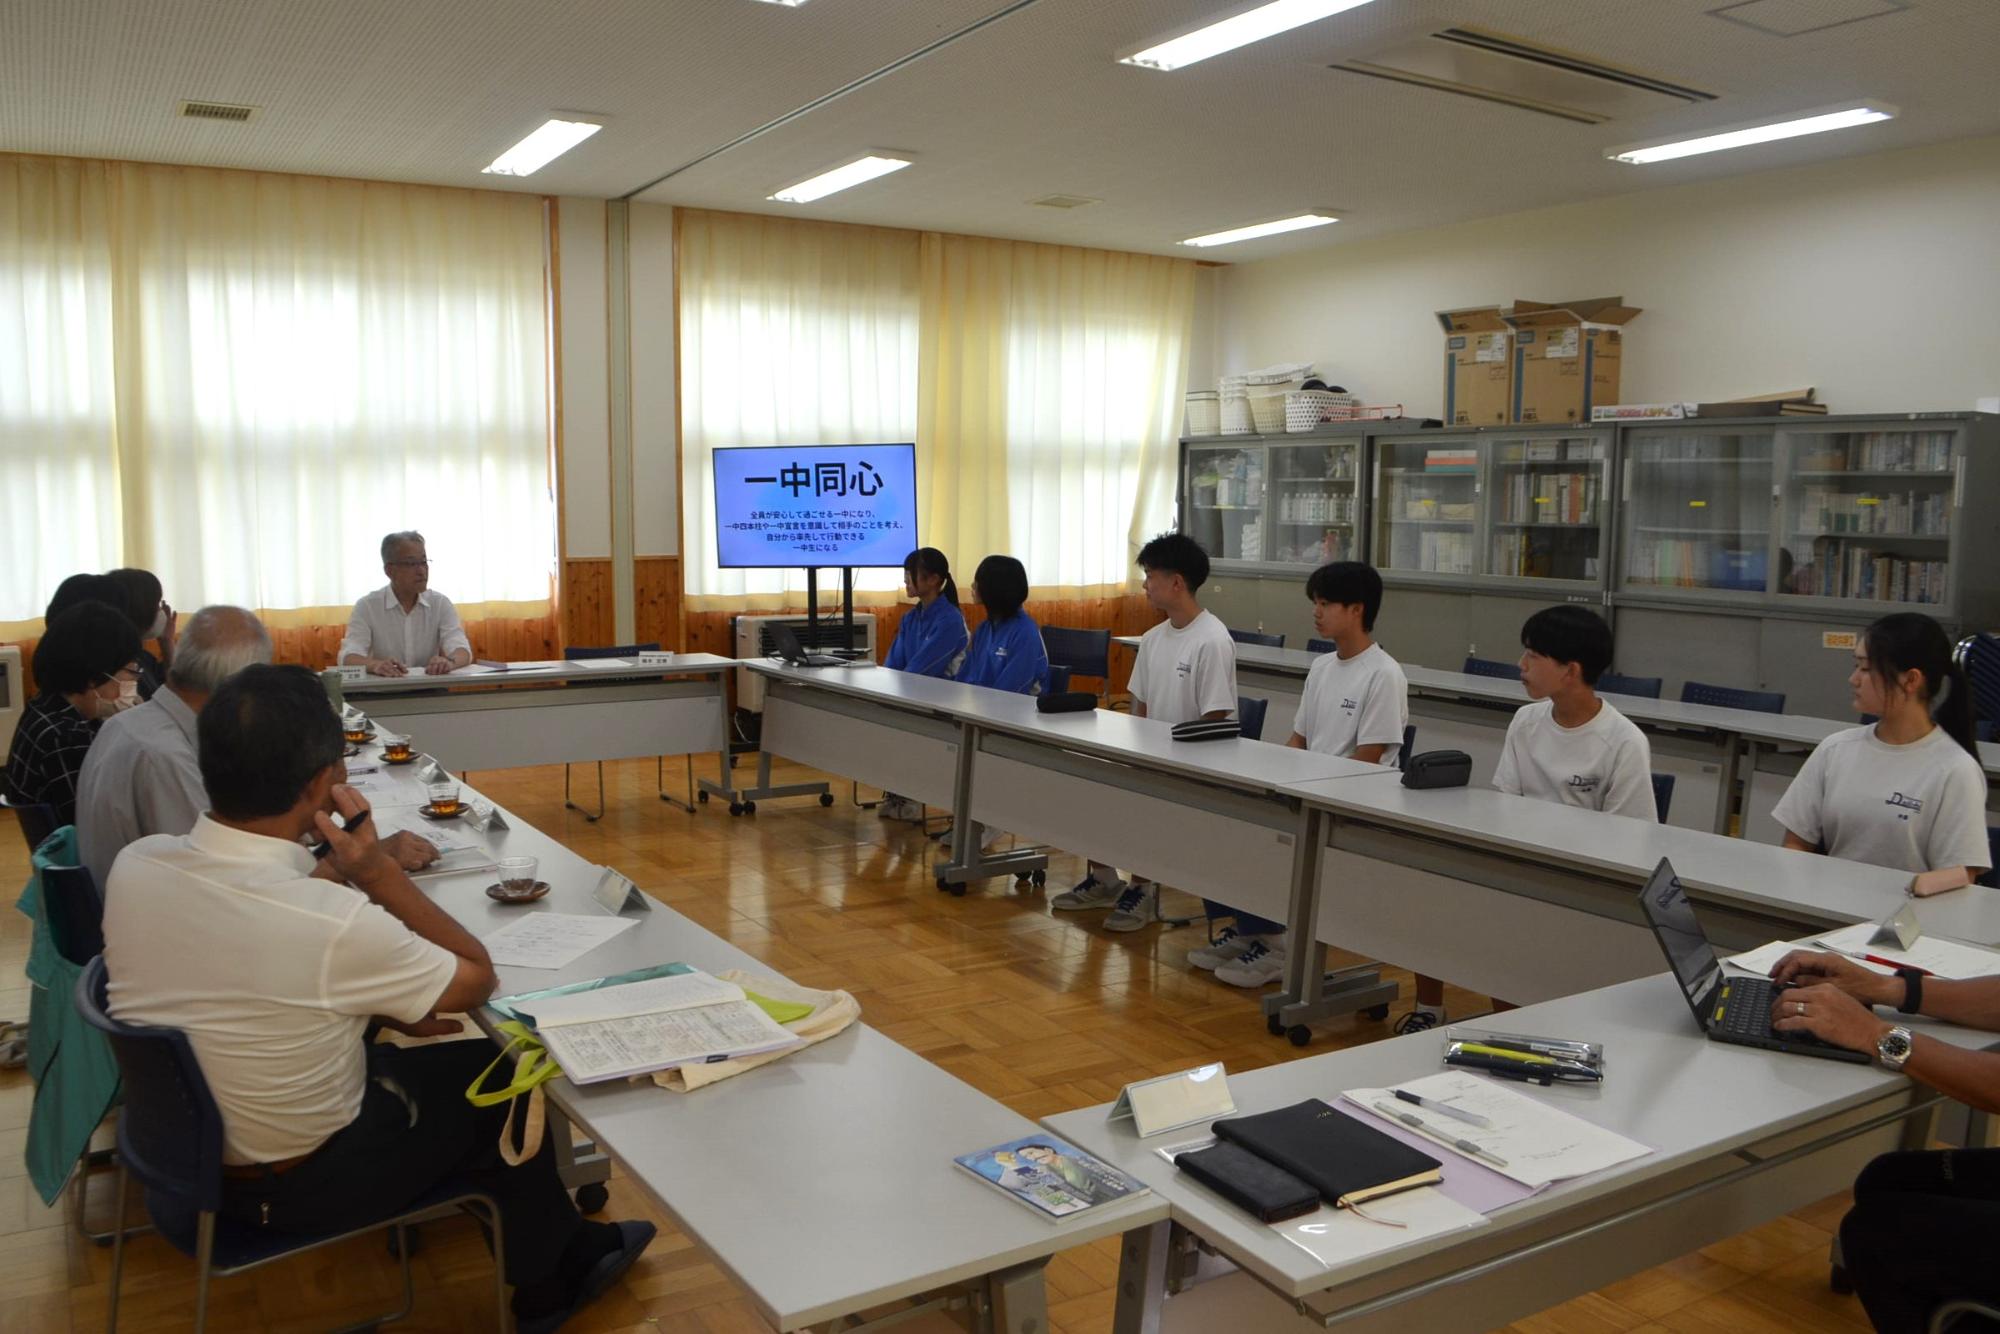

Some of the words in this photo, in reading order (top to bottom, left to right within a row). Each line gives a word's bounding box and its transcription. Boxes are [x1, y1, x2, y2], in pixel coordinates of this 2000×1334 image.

[744, 460, 884, 498] 一中同心
[766, 532, 865, 541] 自分から率先して行動できる
[792, 543, 839, 552] 一中生になる
